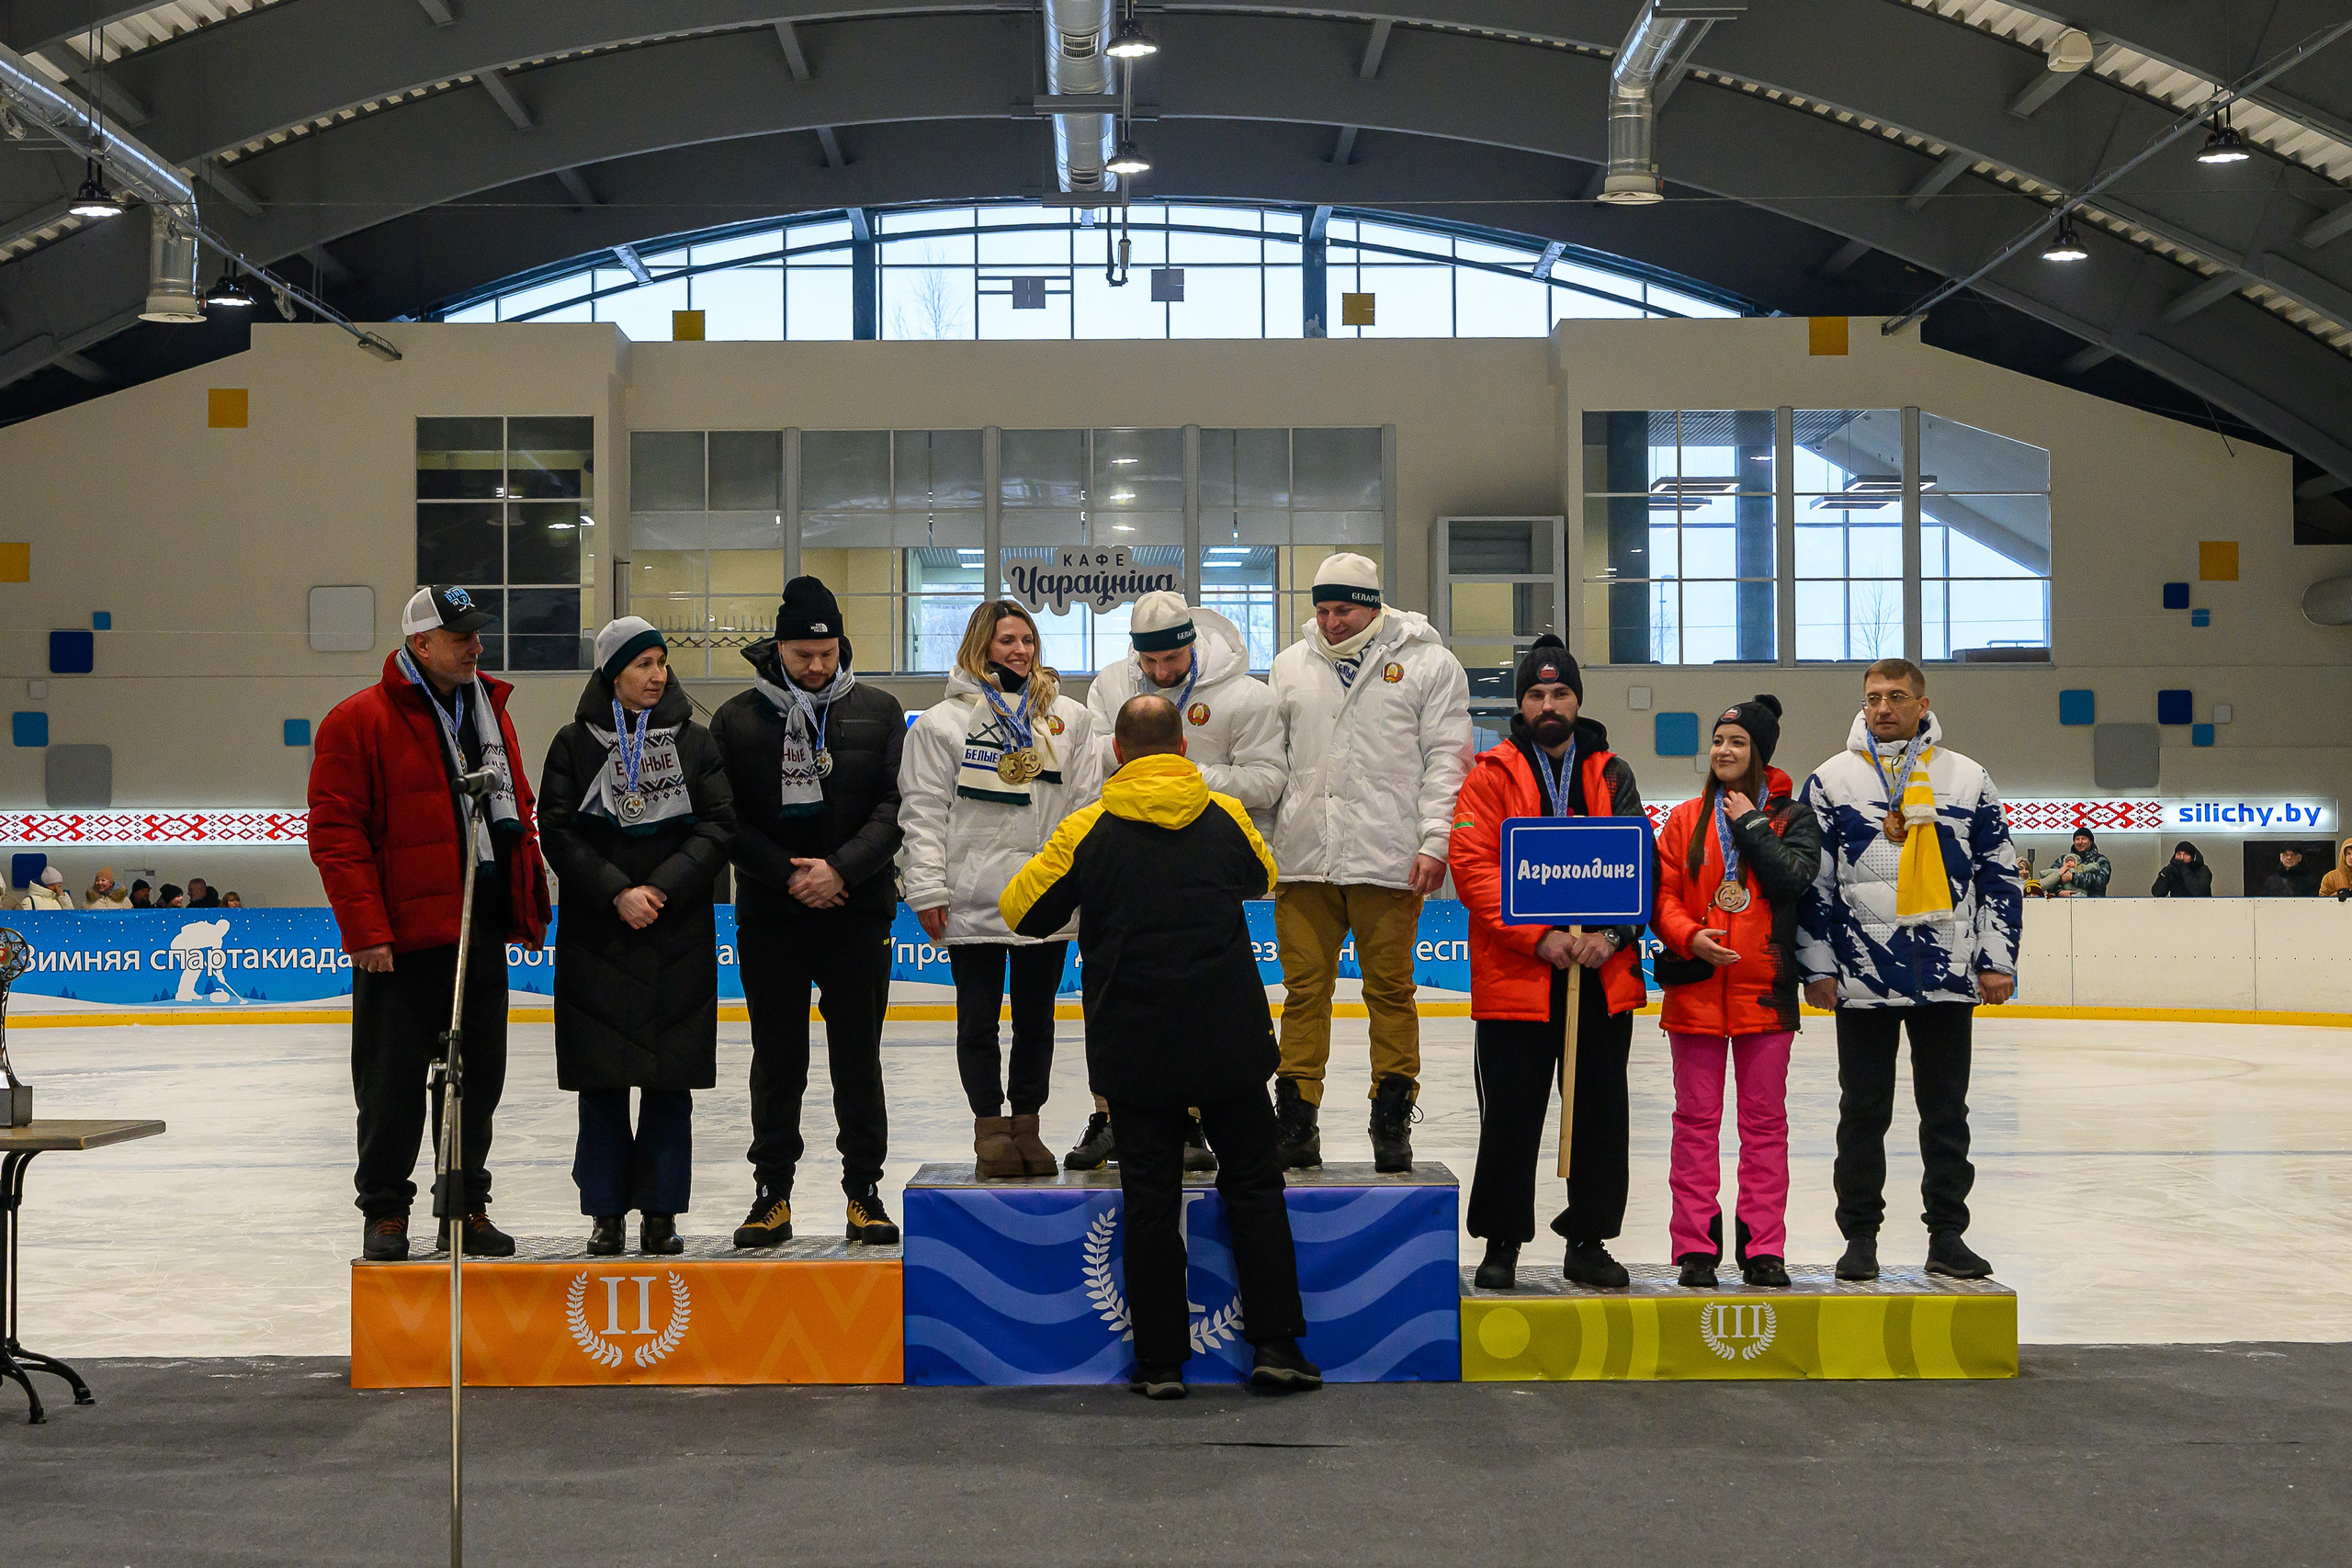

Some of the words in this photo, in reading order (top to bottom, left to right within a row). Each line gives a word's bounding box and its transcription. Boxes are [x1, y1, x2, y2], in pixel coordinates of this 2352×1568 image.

[1063, 553, 1125, 567] КАФЕ
[1012, 566, 1177, 608] Чараўніца
[615, 753, 674, 776] ЕНЫЕ
[965, 749, 998, 763] БЕЛЫЕ
[2179, 803, 2322, 827] silichy.by
[1518, 857, 1635, 885] Агрохолдинг
[150, 947, 353, 976] спартакиада
[599, 1276, 658, 1335] II
[1713, 1304, 1764, 1338] III
